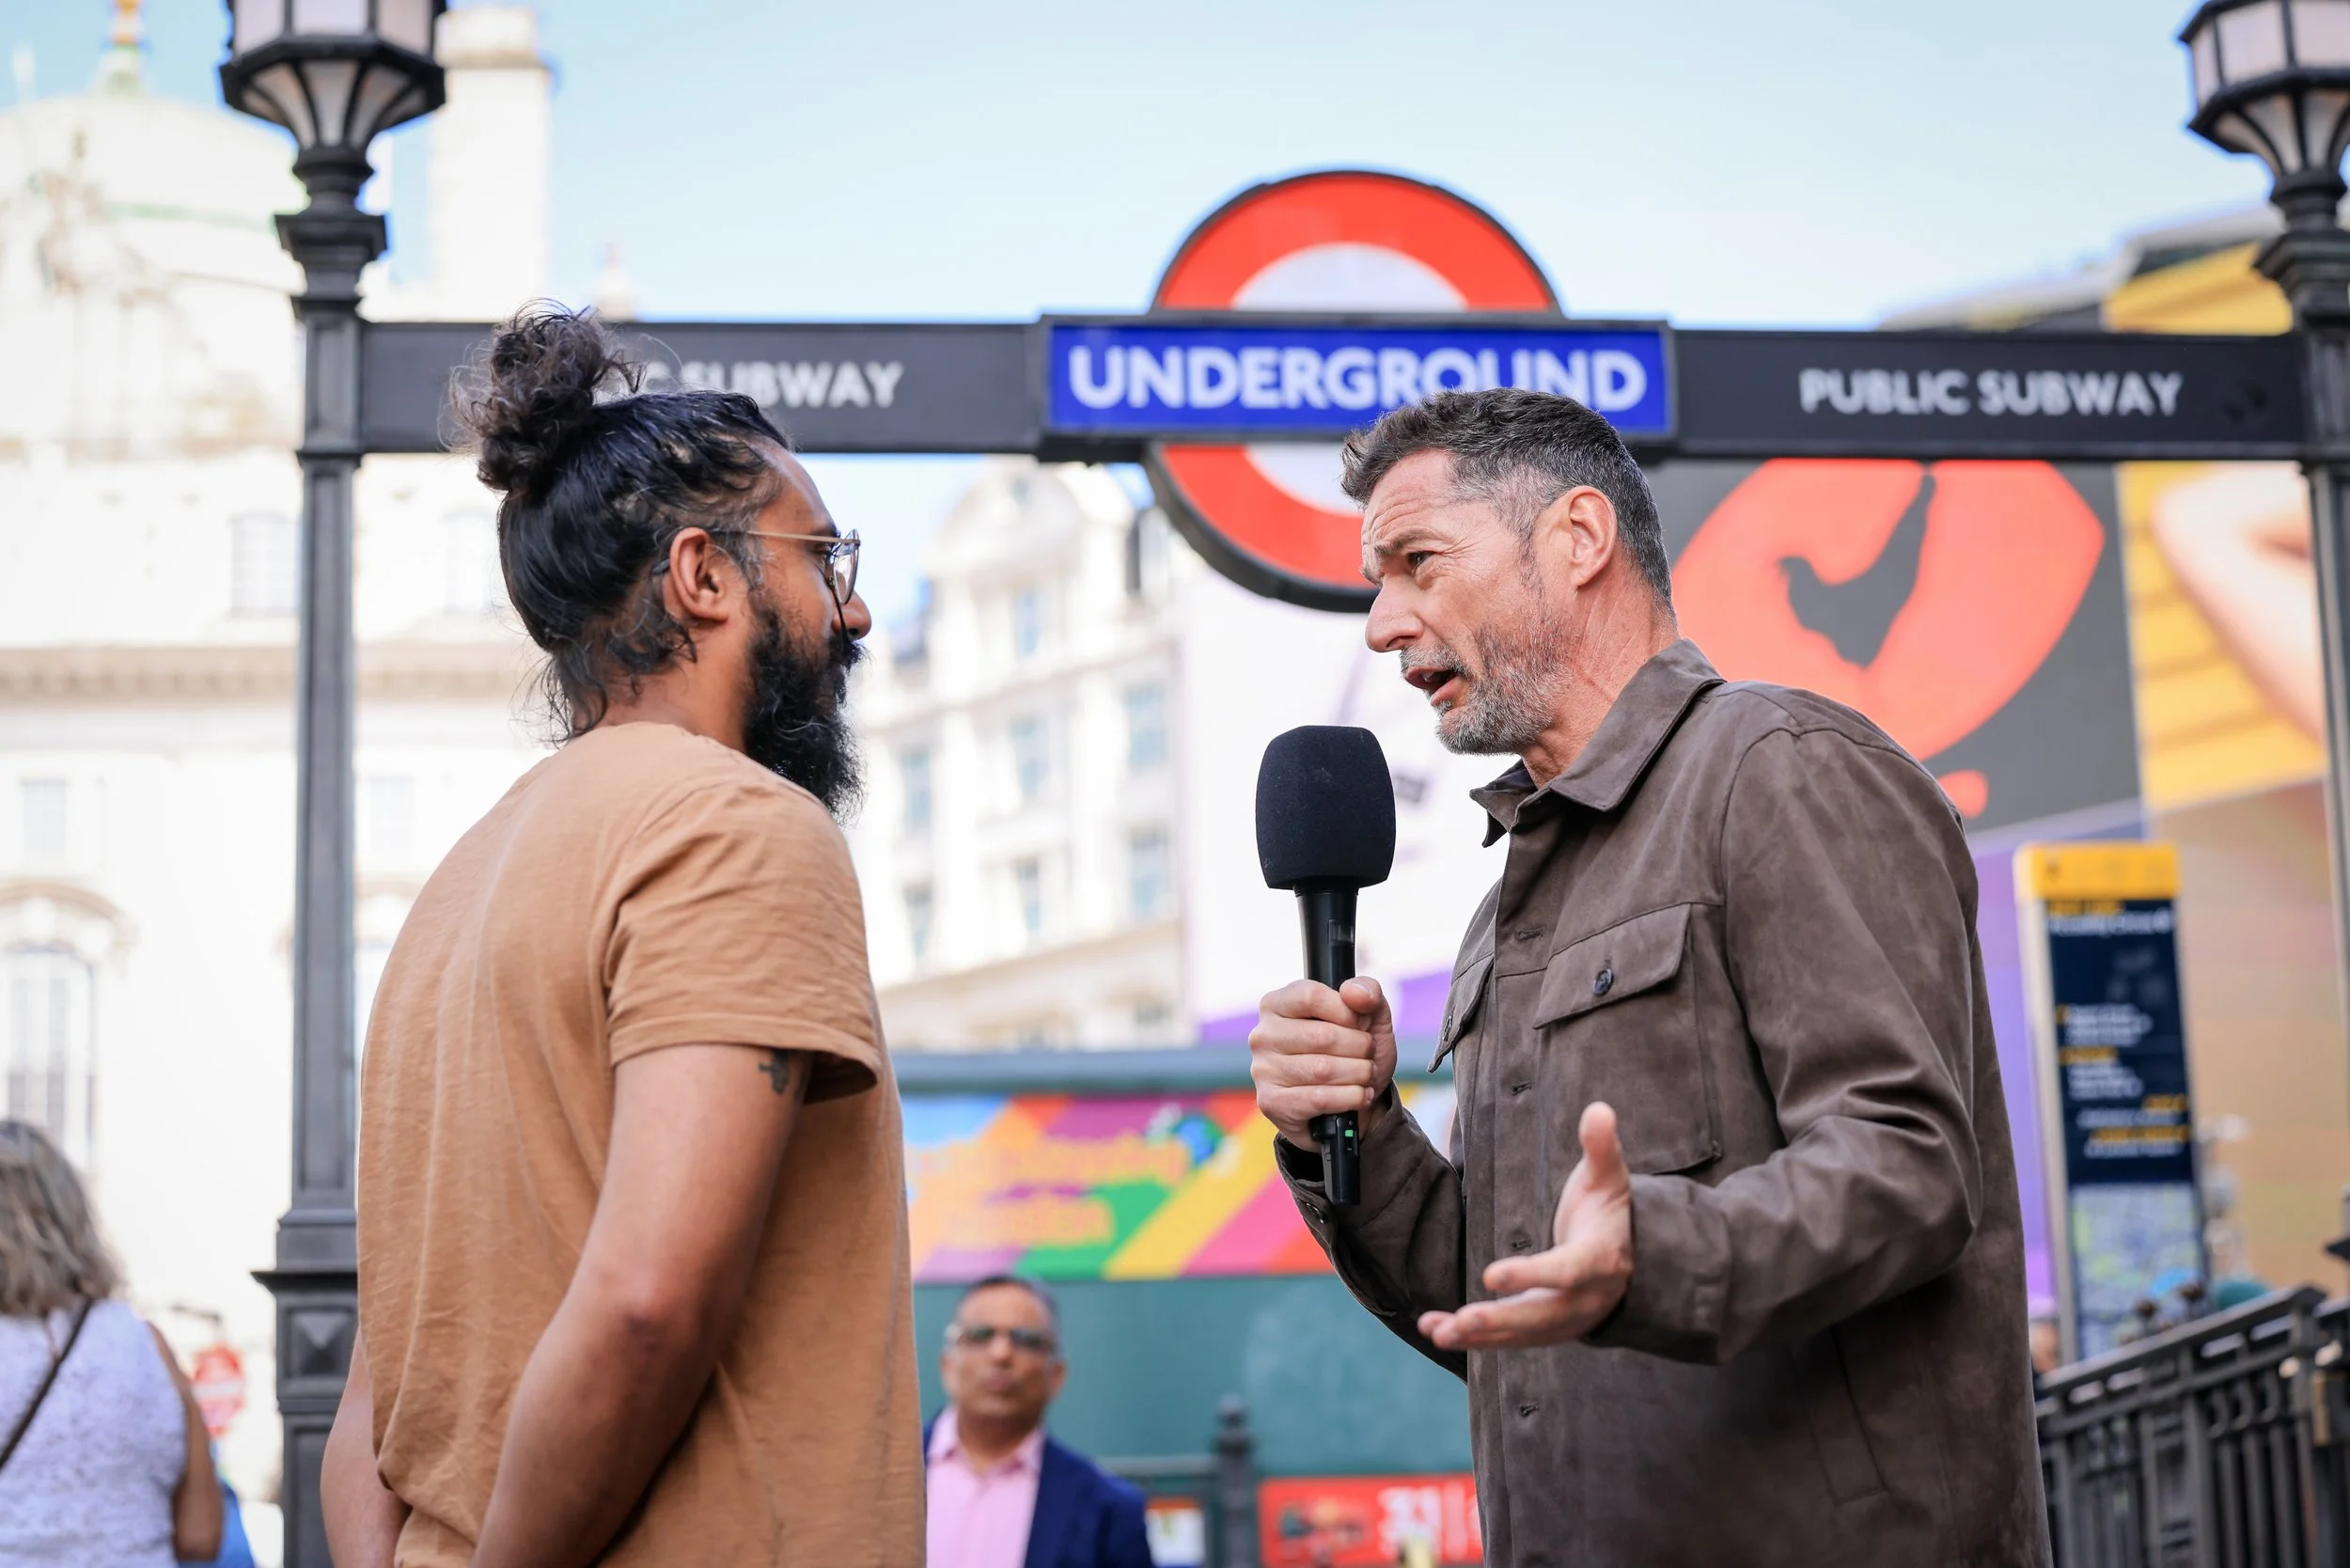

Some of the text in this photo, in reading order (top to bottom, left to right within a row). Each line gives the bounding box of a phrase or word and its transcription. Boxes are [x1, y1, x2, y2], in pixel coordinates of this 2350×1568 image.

[1068, 345, 1648, 412] UNDERGROUND
[1799, 368, 2183, 416] PUBLIC SUBWAY
